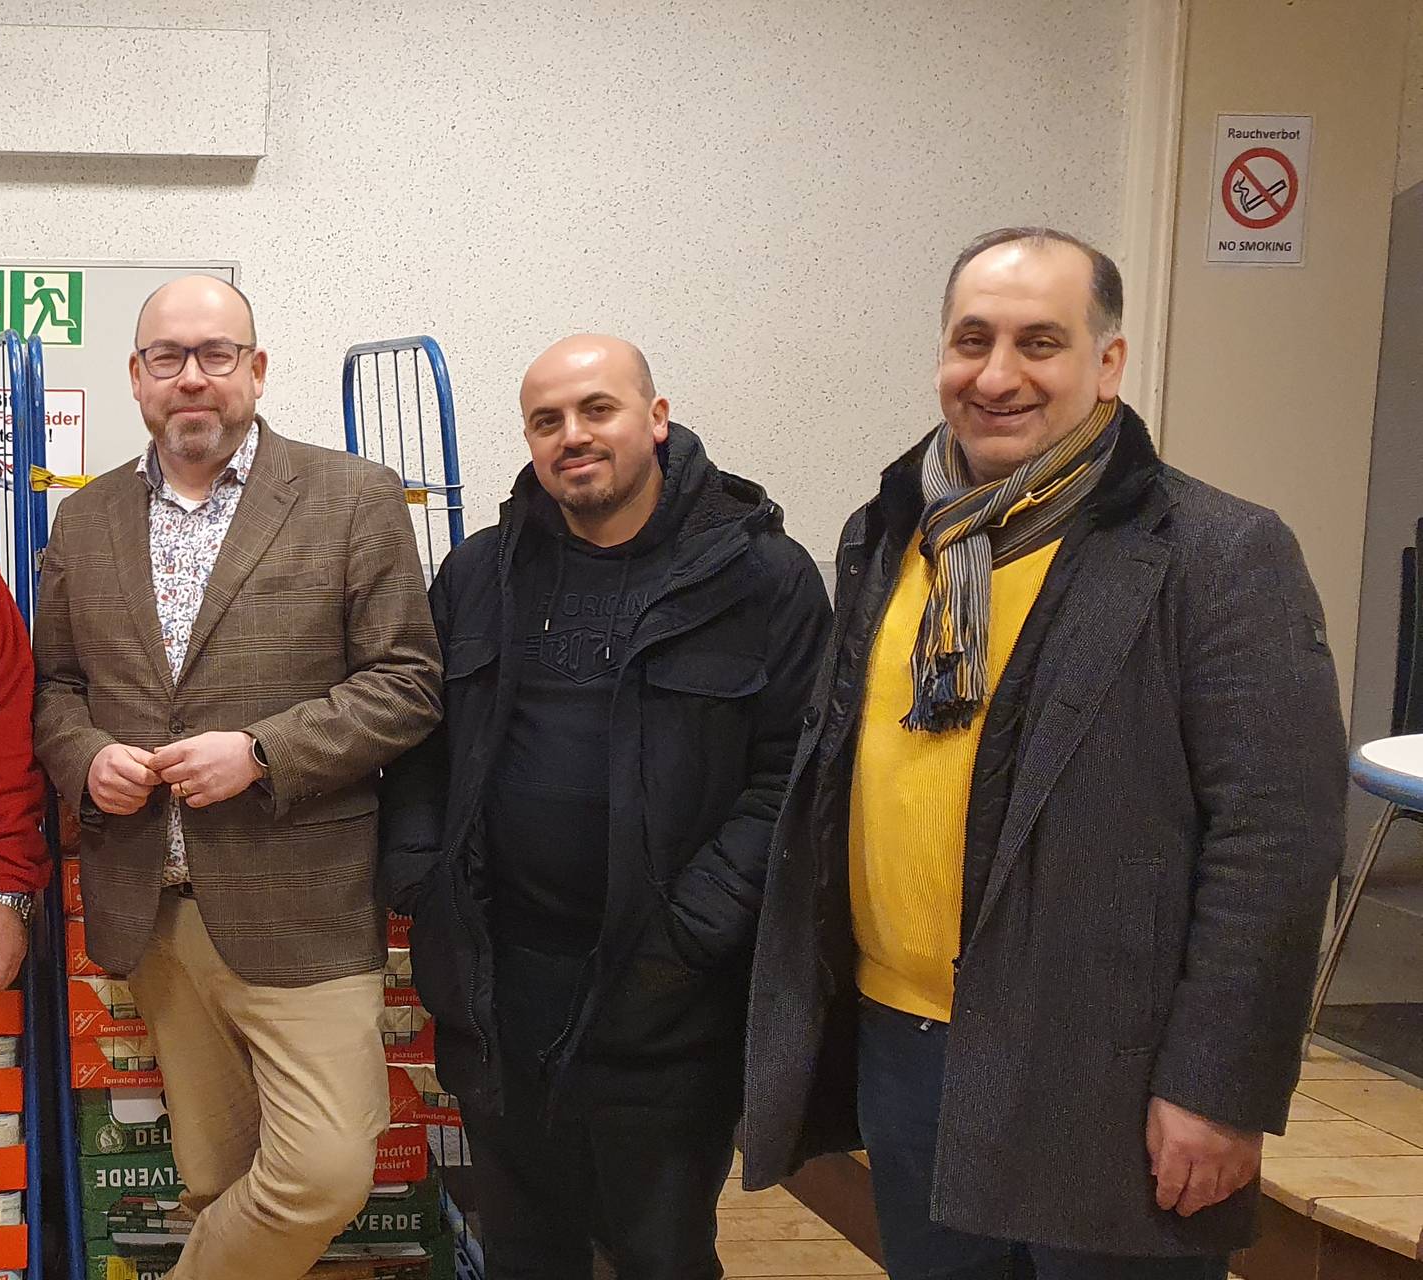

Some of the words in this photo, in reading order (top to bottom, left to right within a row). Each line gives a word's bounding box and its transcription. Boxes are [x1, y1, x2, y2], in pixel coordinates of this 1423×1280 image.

[1228, 128, 1301, 140] Rauchverbot
[1218, 241, 1236, 251] NO
[1239, 241, 1292, 252] SMOKING
[100, 1024, 134, 1033] Tomaten
[102, 1076, 136, 1085] Tomaten
[377, 1145, 422, 1158] maten
[376, 1160, 411, 1171] assiert
[96, 1167, 184, 1188] LVERDE
[345, 1213, 422, 1231] VERDE
